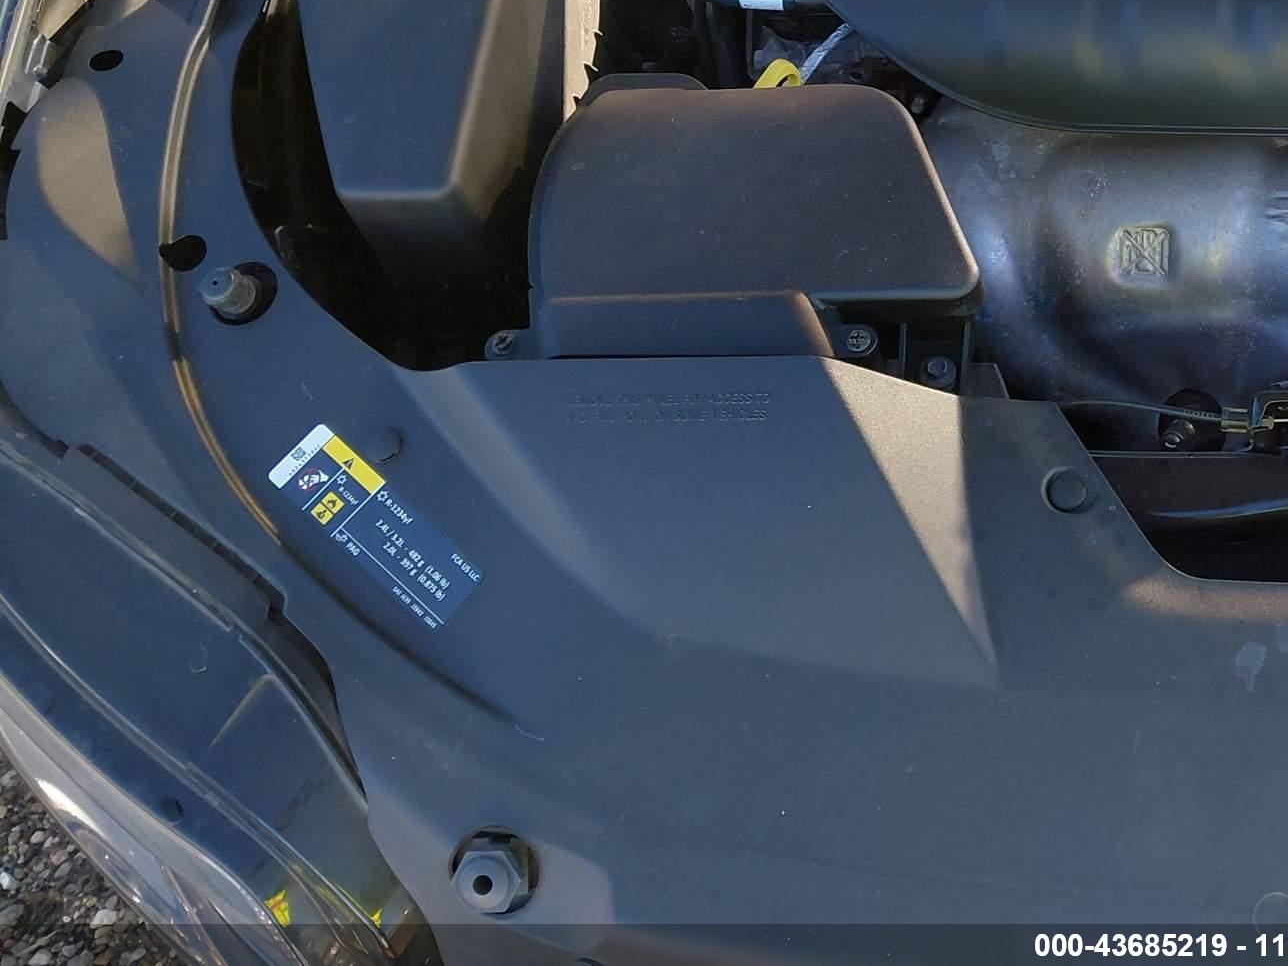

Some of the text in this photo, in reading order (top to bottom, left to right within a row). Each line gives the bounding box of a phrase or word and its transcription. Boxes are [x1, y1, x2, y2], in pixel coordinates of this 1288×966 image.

[385, 499, 413, 524] R-1234yf
[346, 543, 360, 556] PAG
[450, 554, 480, 582] FCA US LLC
